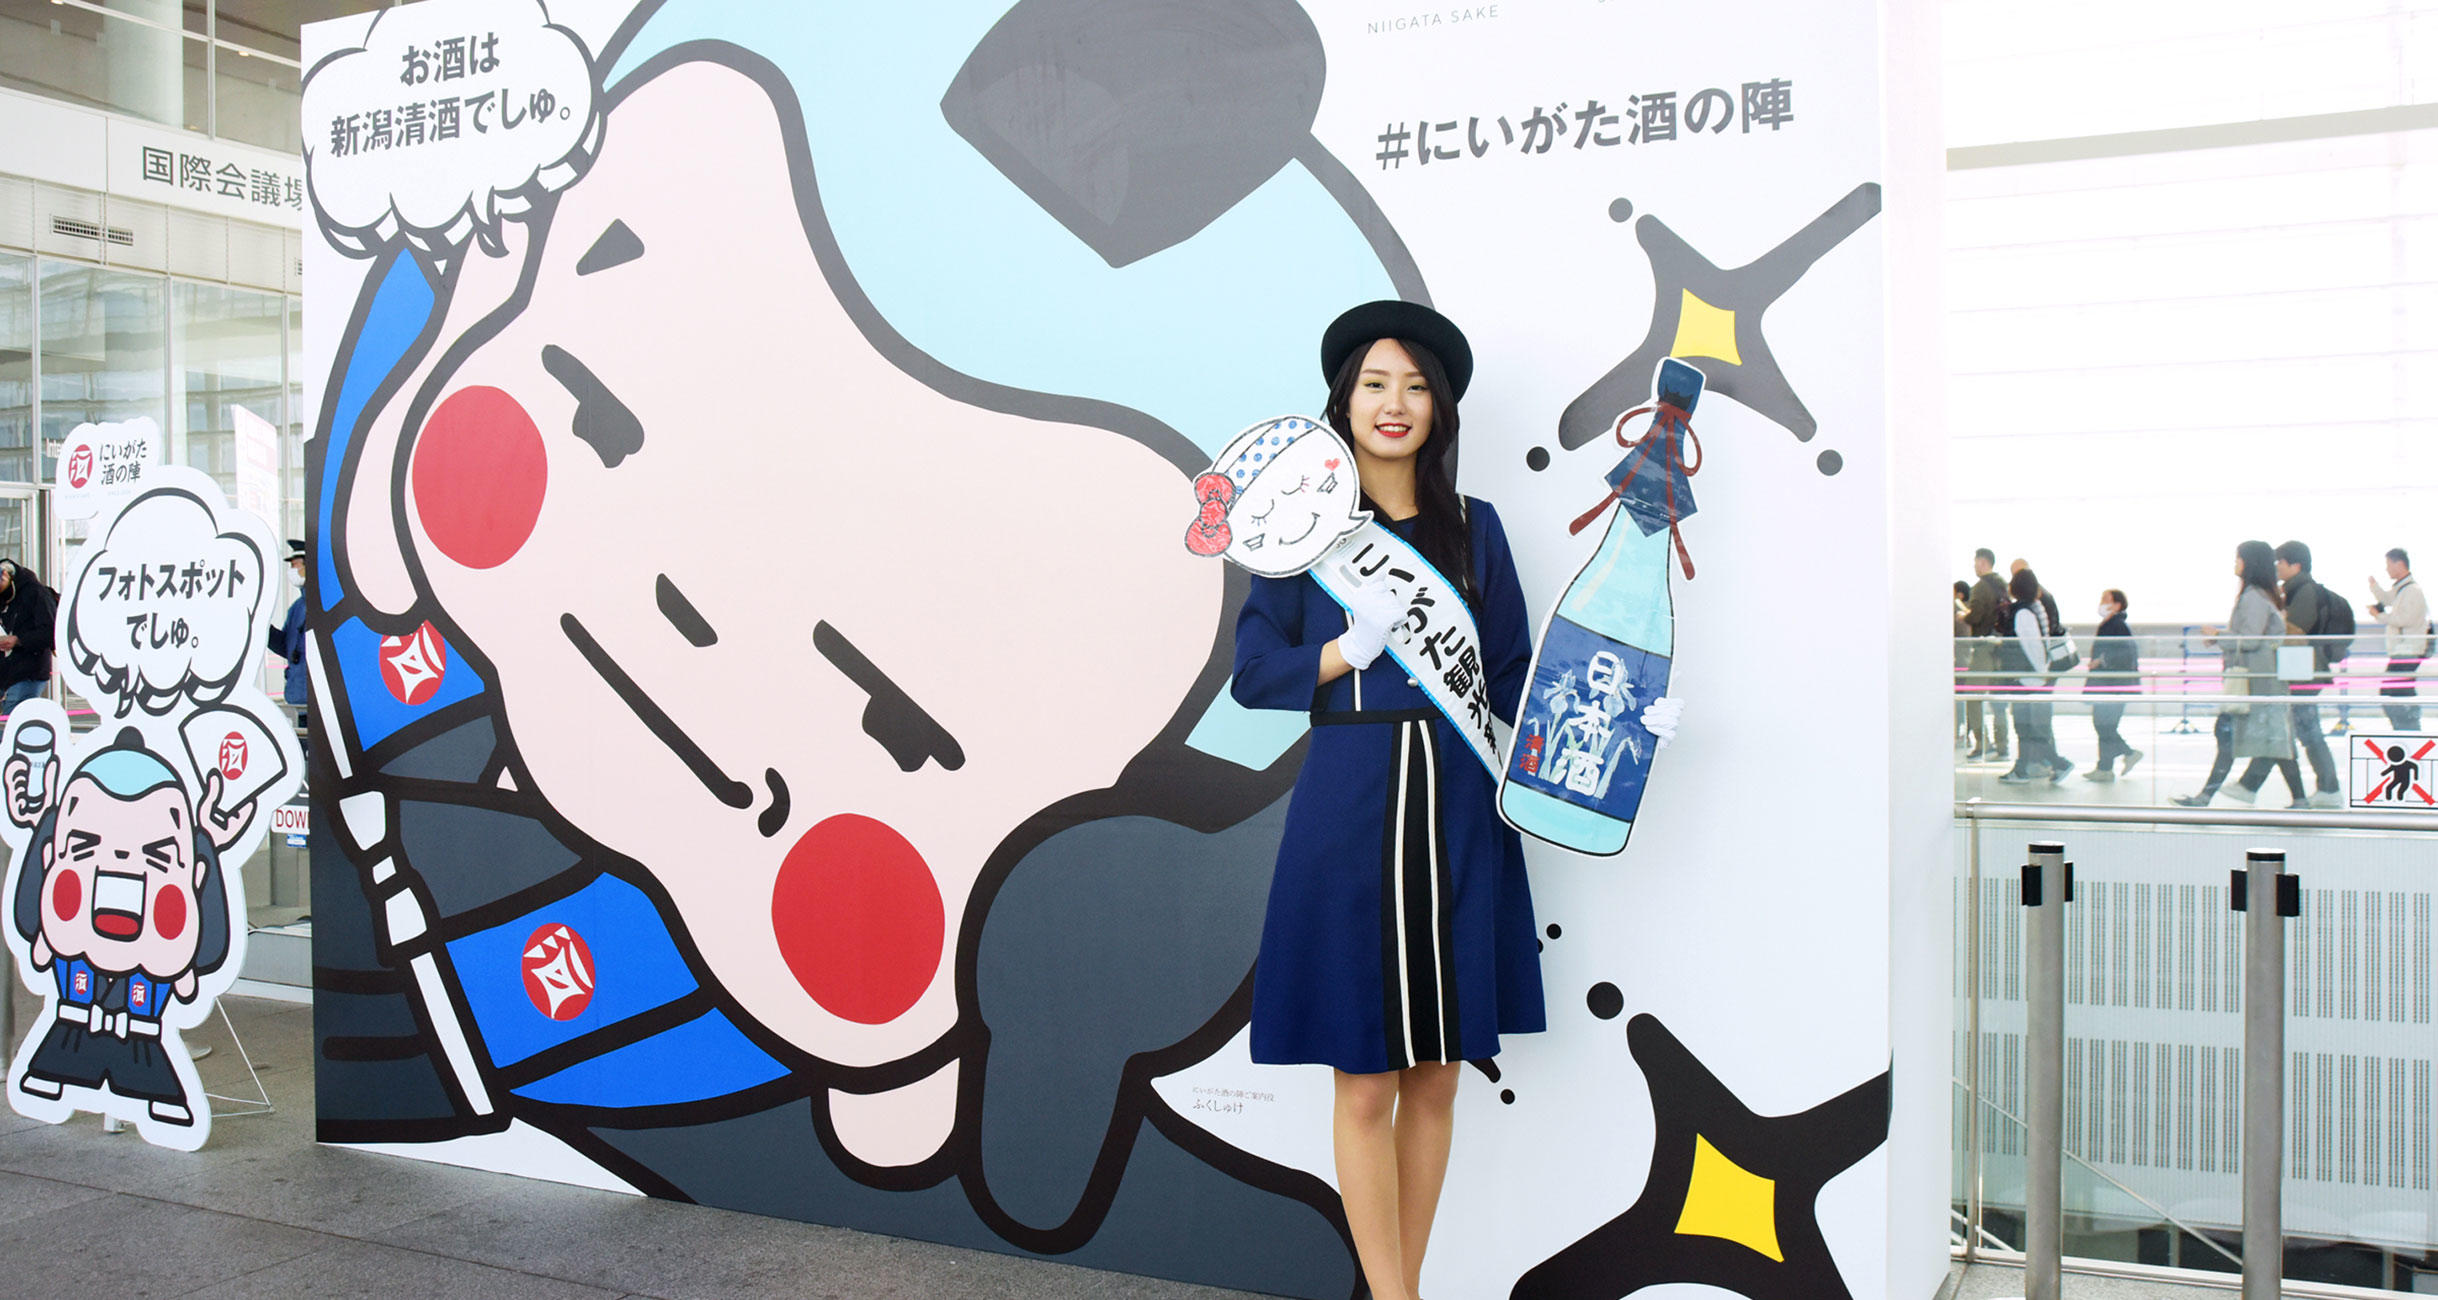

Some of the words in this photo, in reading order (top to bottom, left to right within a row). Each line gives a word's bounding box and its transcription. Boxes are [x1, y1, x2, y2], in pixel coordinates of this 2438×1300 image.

[1367, 12, 1442, 34] NIIGATA
[1450, 4, 1499, 23] SAKE
[400, 31, 500, 87] お酒は
[330, 87, 571, 158] 新潟清酒でしゅ。
[1375, 78, 1795, 171] #にいがた酒の陣
[99, 439, 147, 462] にいがた
[101, 462, 141, 486] 酒の陣
[98, 559, 245, 602] フォトスポット
[126, 612, 200, 650] でしゅ。
[1551, 650, 1622, 797] 日本酒
[276, 808, 310, 830] DOW
